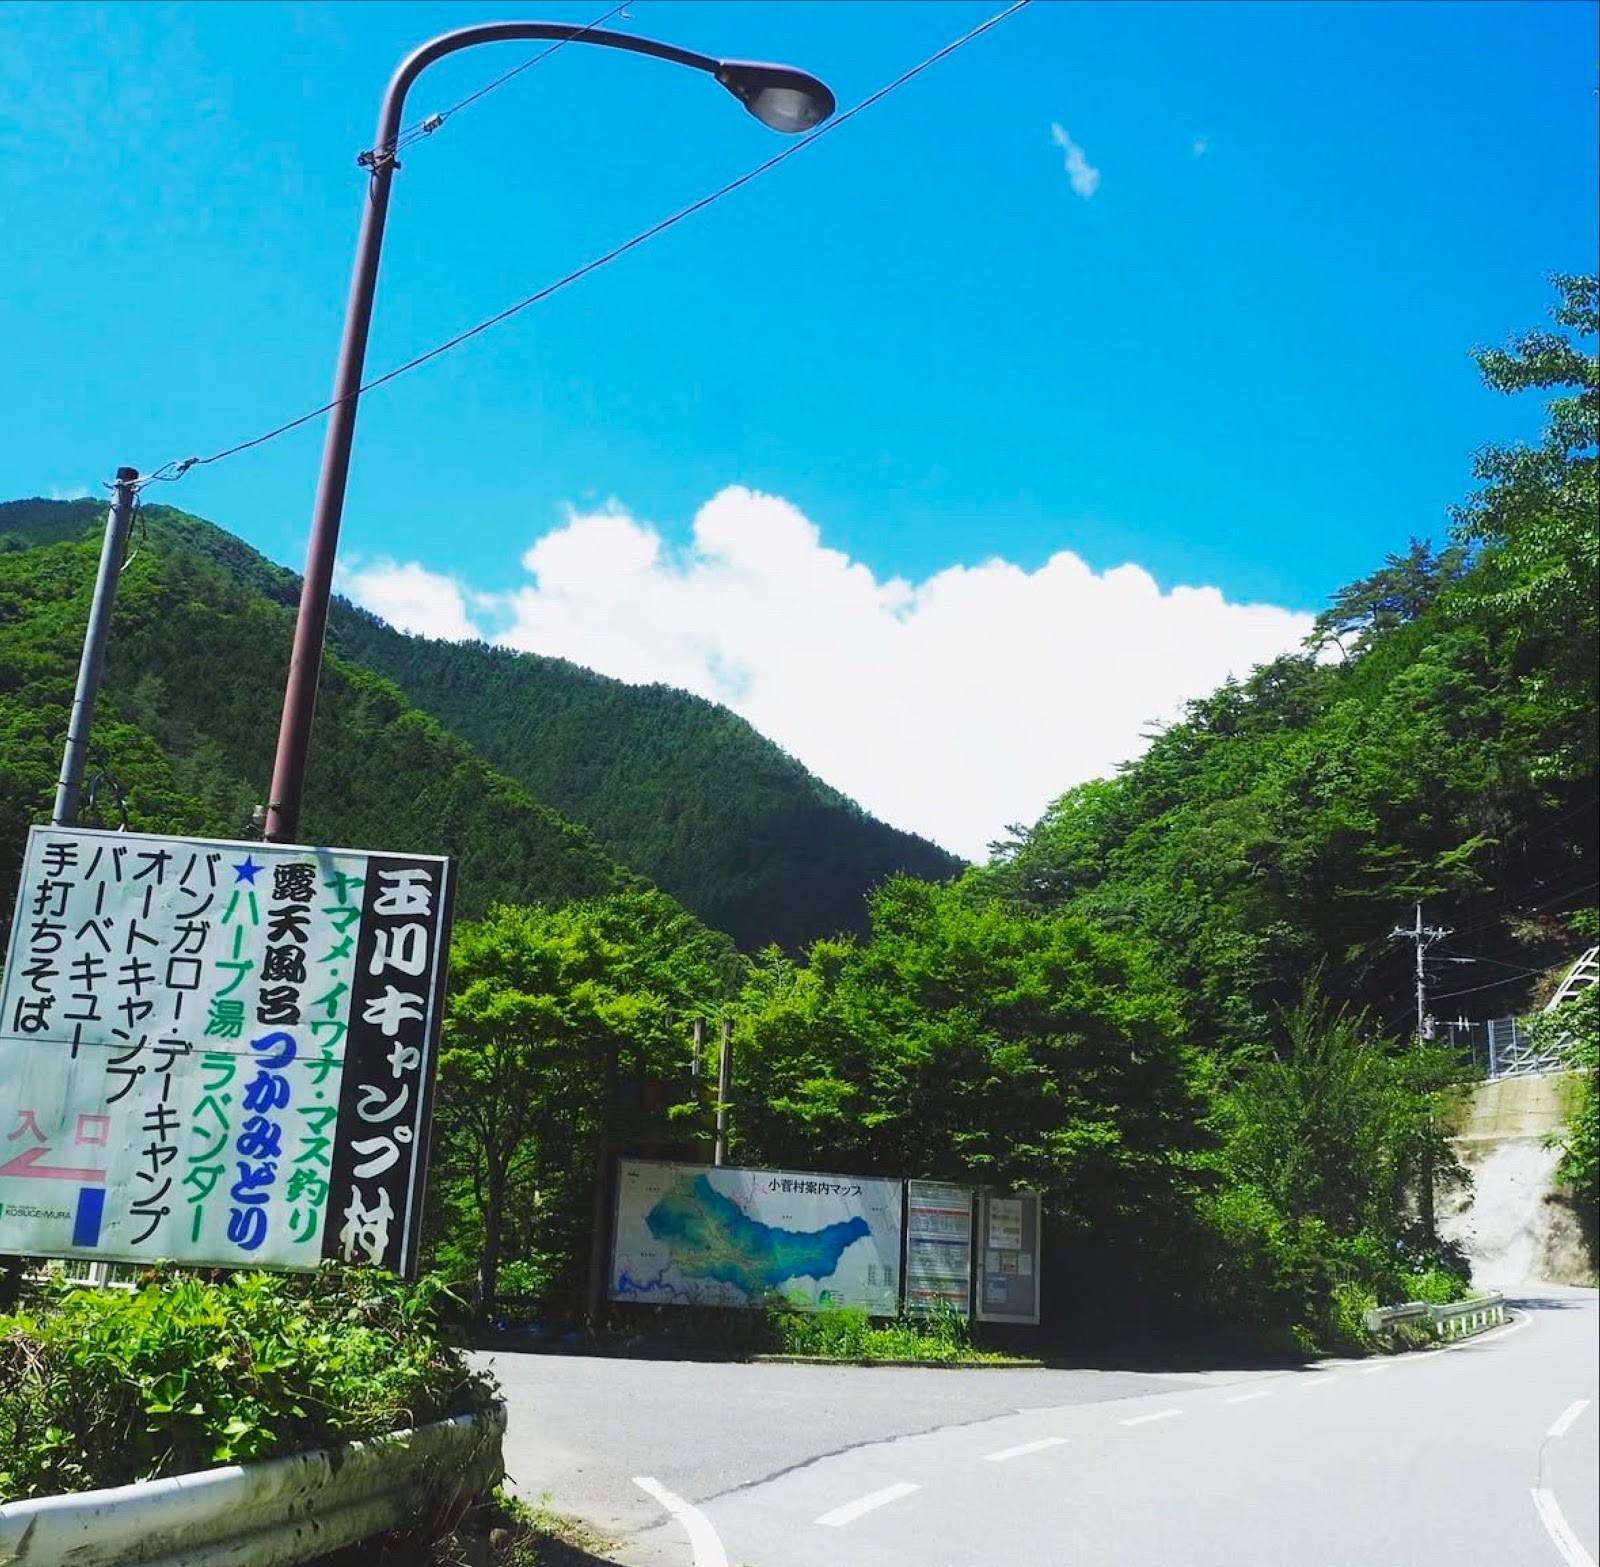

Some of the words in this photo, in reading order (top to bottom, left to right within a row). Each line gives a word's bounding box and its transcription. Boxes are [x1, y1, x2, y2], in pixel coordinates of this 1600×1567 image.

[13, 842, 79, 1033] 手打ちそば
[203, 890, 260, 1039] ハーブ湯
[256, 862, 318, 1026] 露天風呂
[8, 1110, 111, 1147] 入口
[182, 1054, 236, 1243] ラベンダー
[227, 1032, 297, 1250] つかみどり
[340, 868, 433, 1266] 玉川キャンプ村
